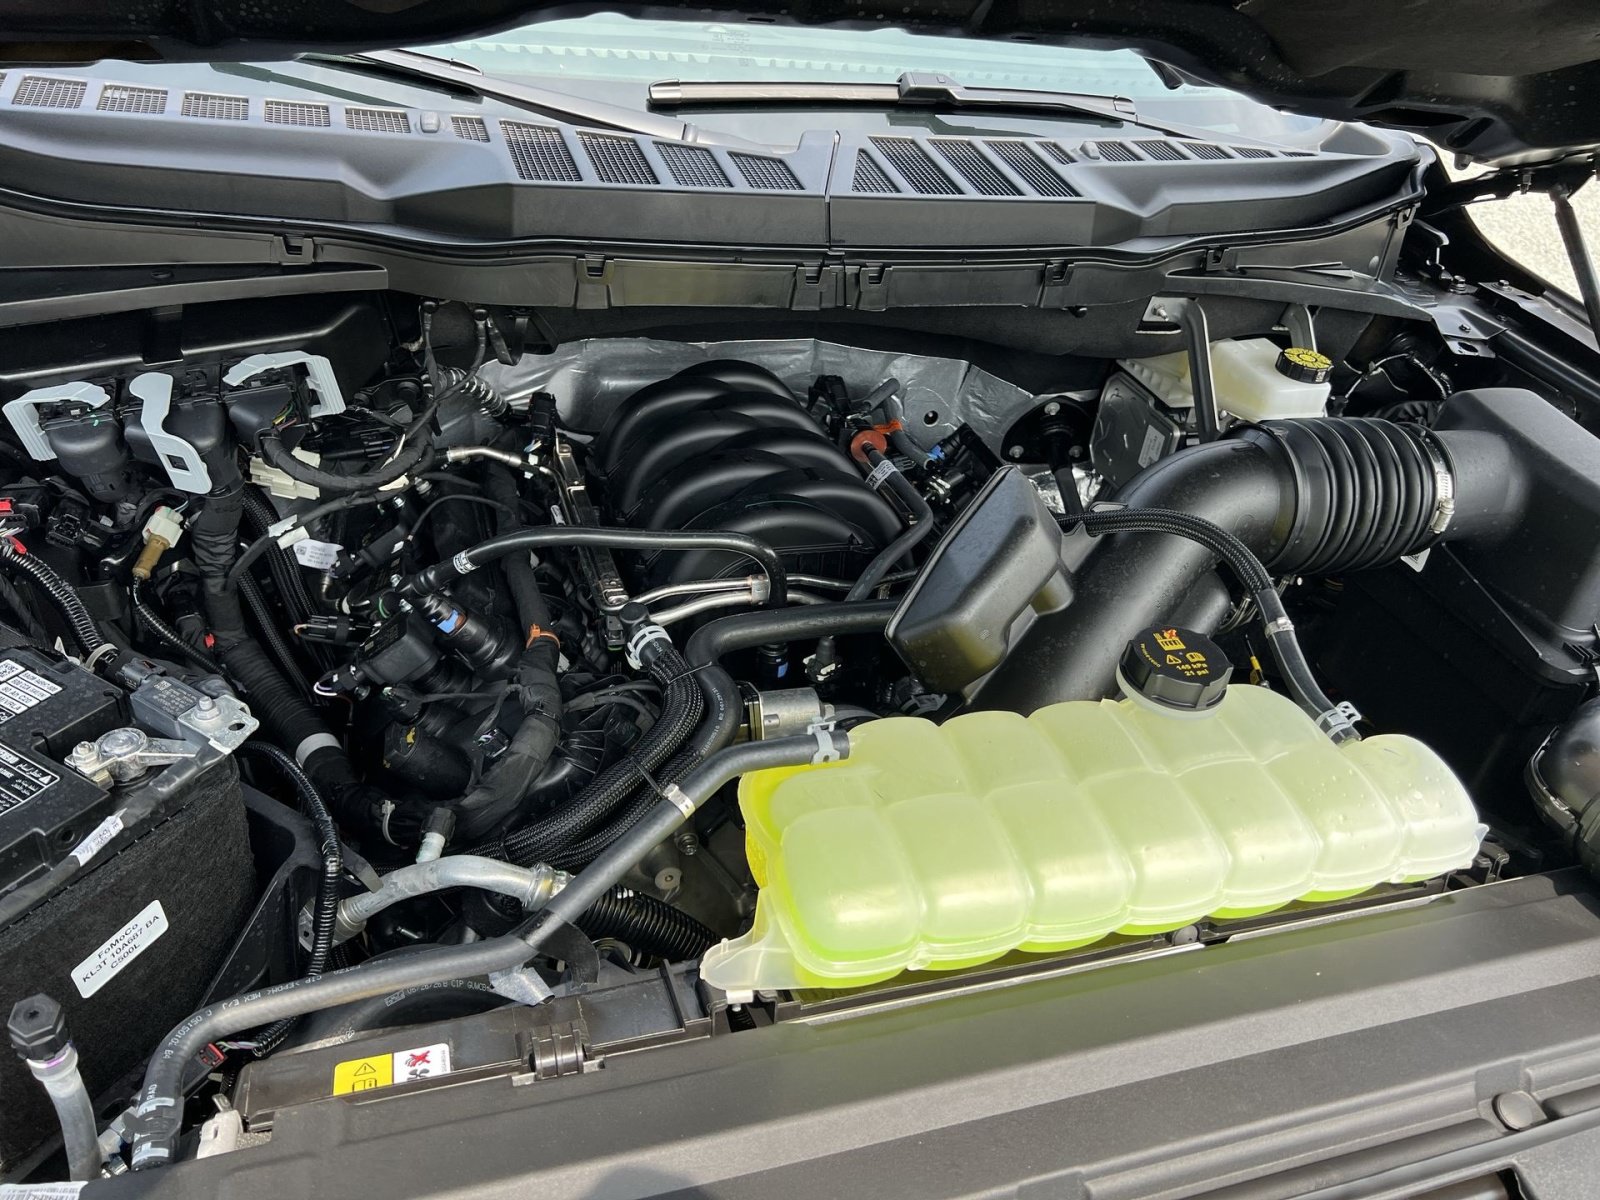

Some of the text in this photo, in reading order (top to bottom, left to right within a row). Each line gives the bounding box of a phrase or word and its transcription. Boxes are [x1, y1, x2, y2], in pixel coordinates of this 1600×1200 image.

[82, 915, 160, 983] KL3T 10A687 BA
[98, 923, 139, 959] FoMoCo
[110, 943, 141, 969] C500L
